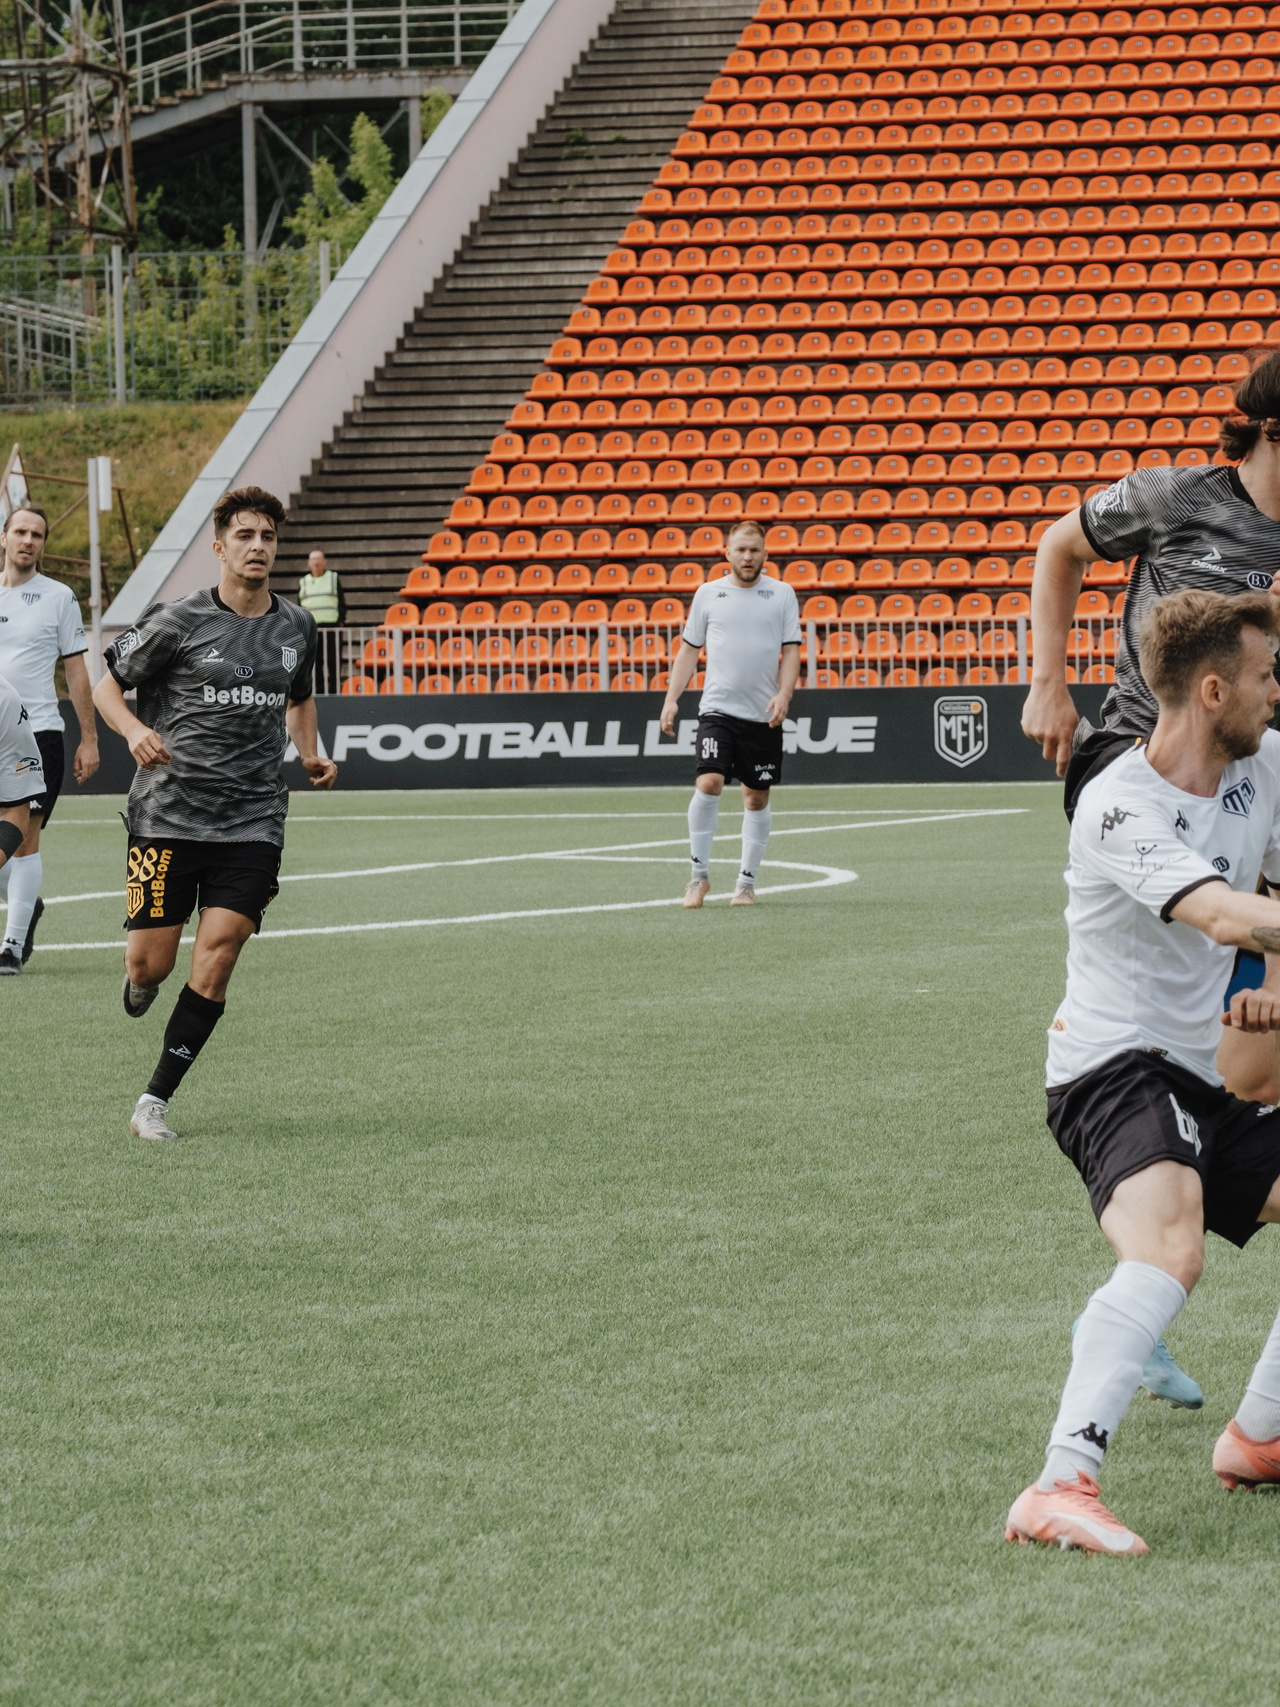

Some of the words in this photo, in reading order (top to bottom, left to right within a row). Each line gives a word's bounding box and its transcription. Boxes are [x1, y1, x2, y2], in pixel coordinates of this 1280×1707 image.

[1191, 559, 1227, 573] DEMIX
[203, 685, 286, 706] BetBoom
[332, 720, 639, 762] FOOTBALL
[643, 716, 878, 757] LEUE
[701, 737, 719, 759] 34
[150, 848, 173, 918] BetBoom
